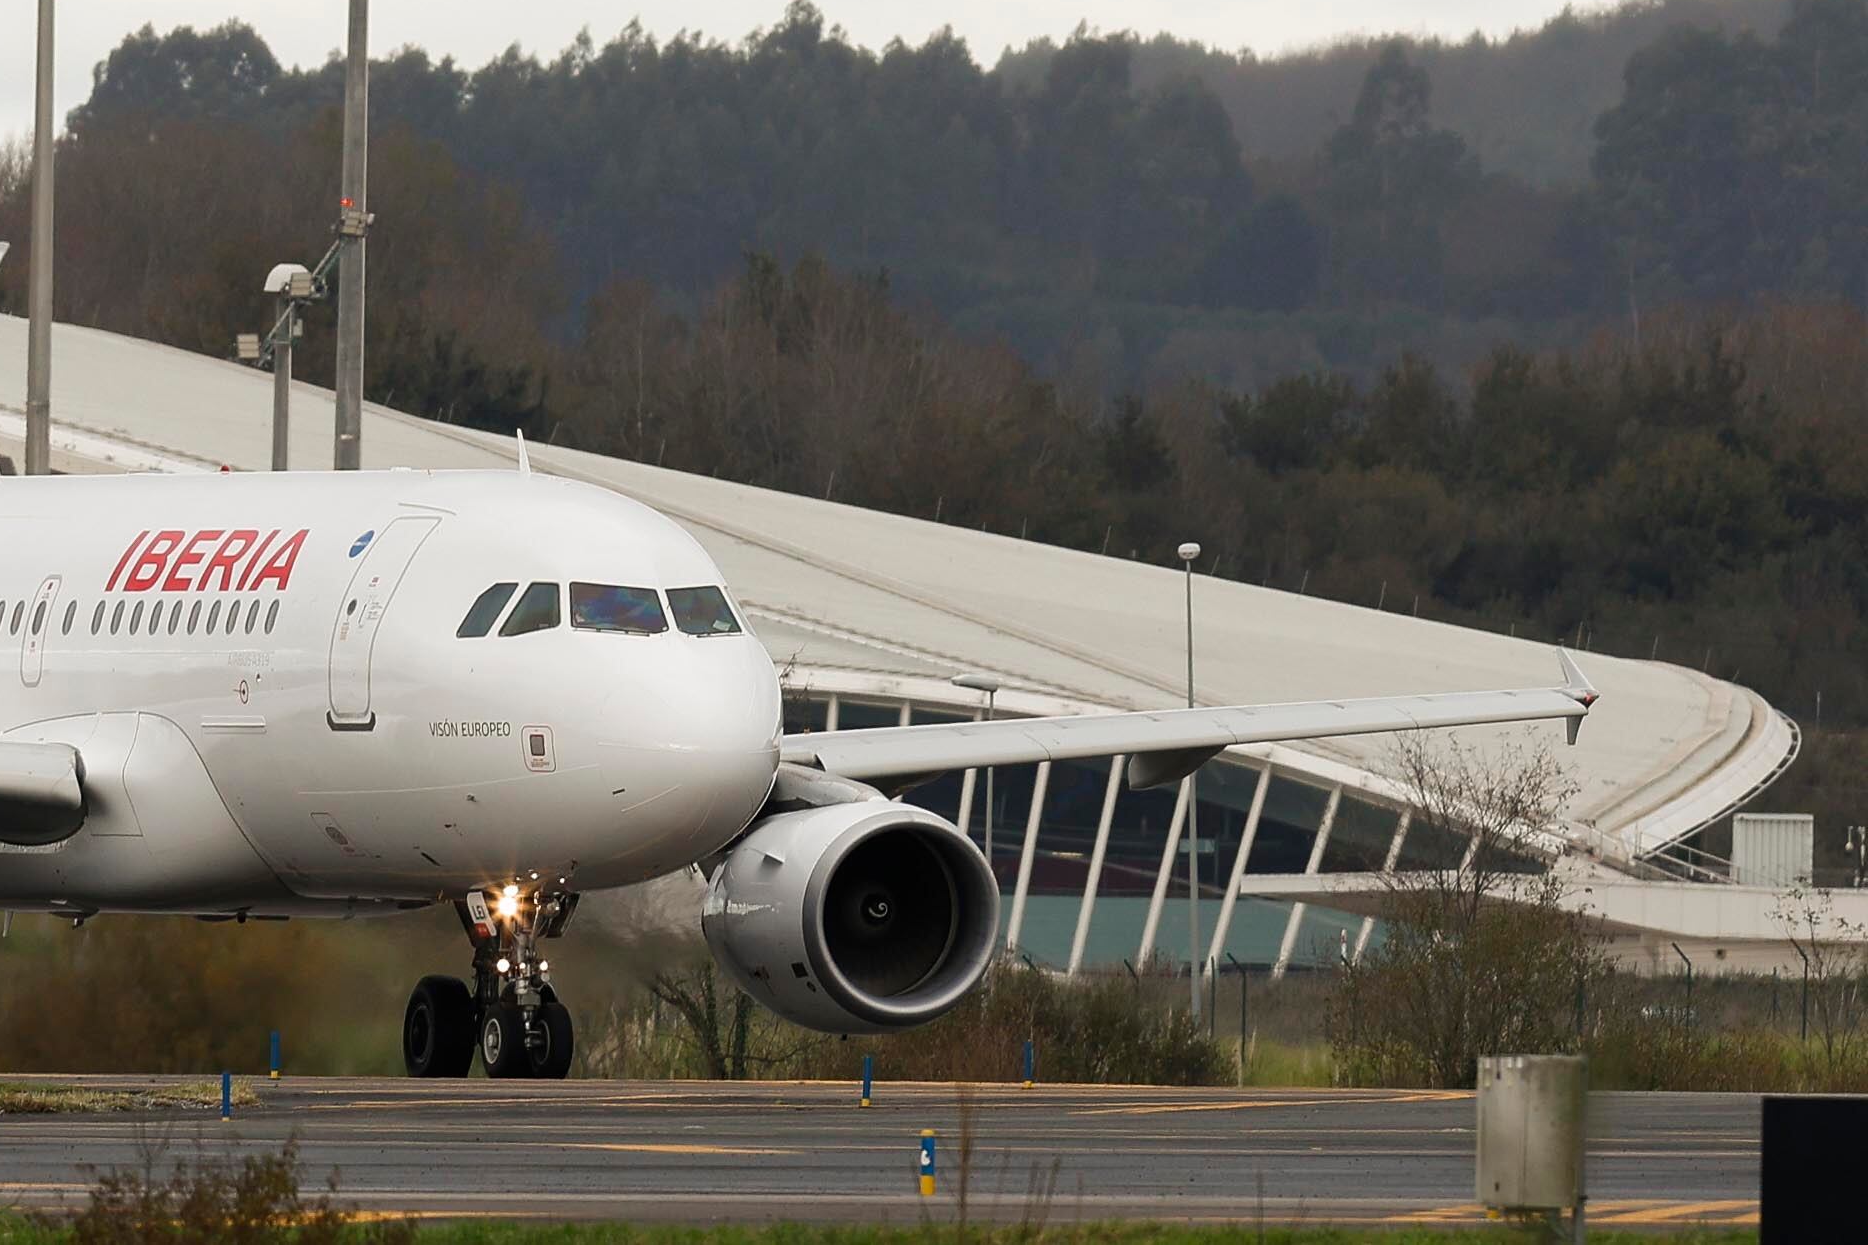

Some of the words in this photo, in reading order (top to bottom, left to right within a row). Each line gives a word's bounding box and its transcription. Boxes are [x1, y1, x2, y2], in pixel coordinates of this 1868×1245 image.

[104, 529, 310, 592] IBERIA
[428, 718, 458, 737] VISÓN
[461, 721, 511, 737] EUROPEO
[472, 905, 486, 920] LEI
